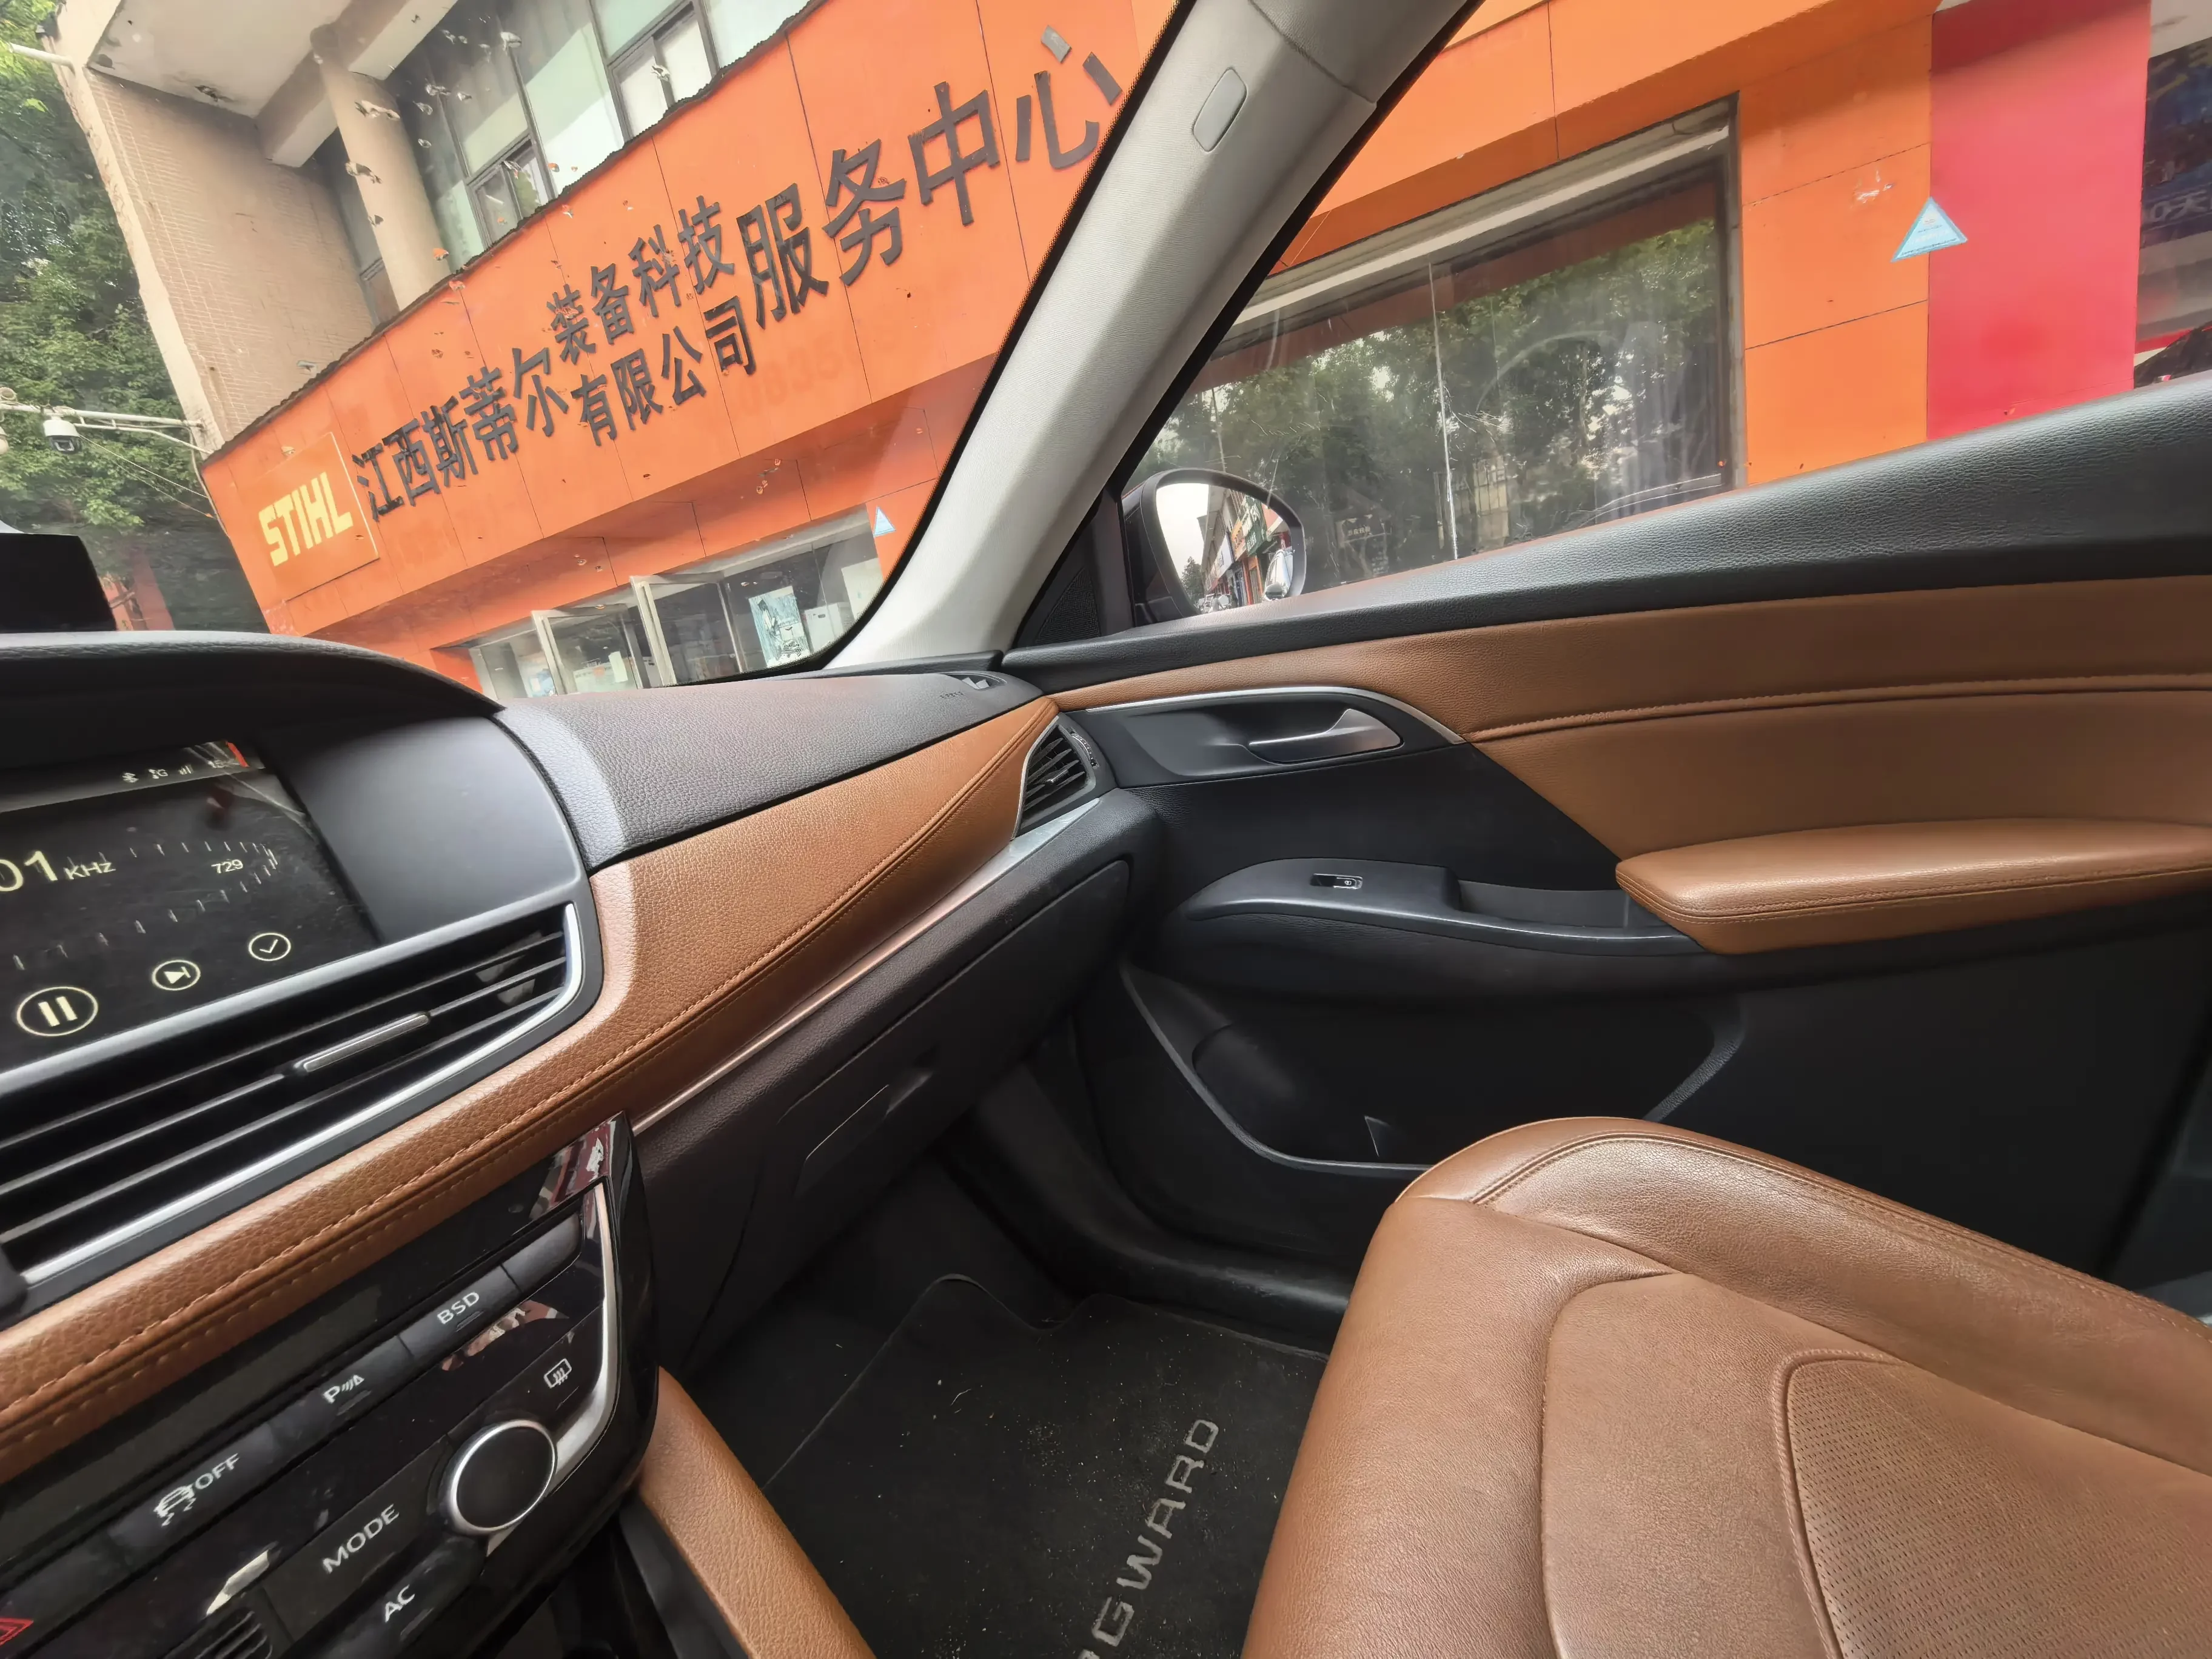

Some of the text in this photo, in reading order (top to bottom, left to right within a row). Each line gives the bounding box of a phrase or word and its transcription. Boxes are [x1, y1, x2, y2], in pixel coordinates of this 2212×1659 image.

[736, 25, 1123, 330] 服务中心
[546, 195, 735, 365] 装备科技
[571, 295, 757, 447] 有限公司
[352, 347, 569, 522] 江西斯蒂尔
[258, 472, 354, 567] STIHL
[211, 859, 244, 874] 729
[437, 1291, 480, 1325] BSD
[195, 1453, 240, 1489] OFF
[323, 1504, 399, 1573] MODE
[384, 1585, 415, 1623] AC
